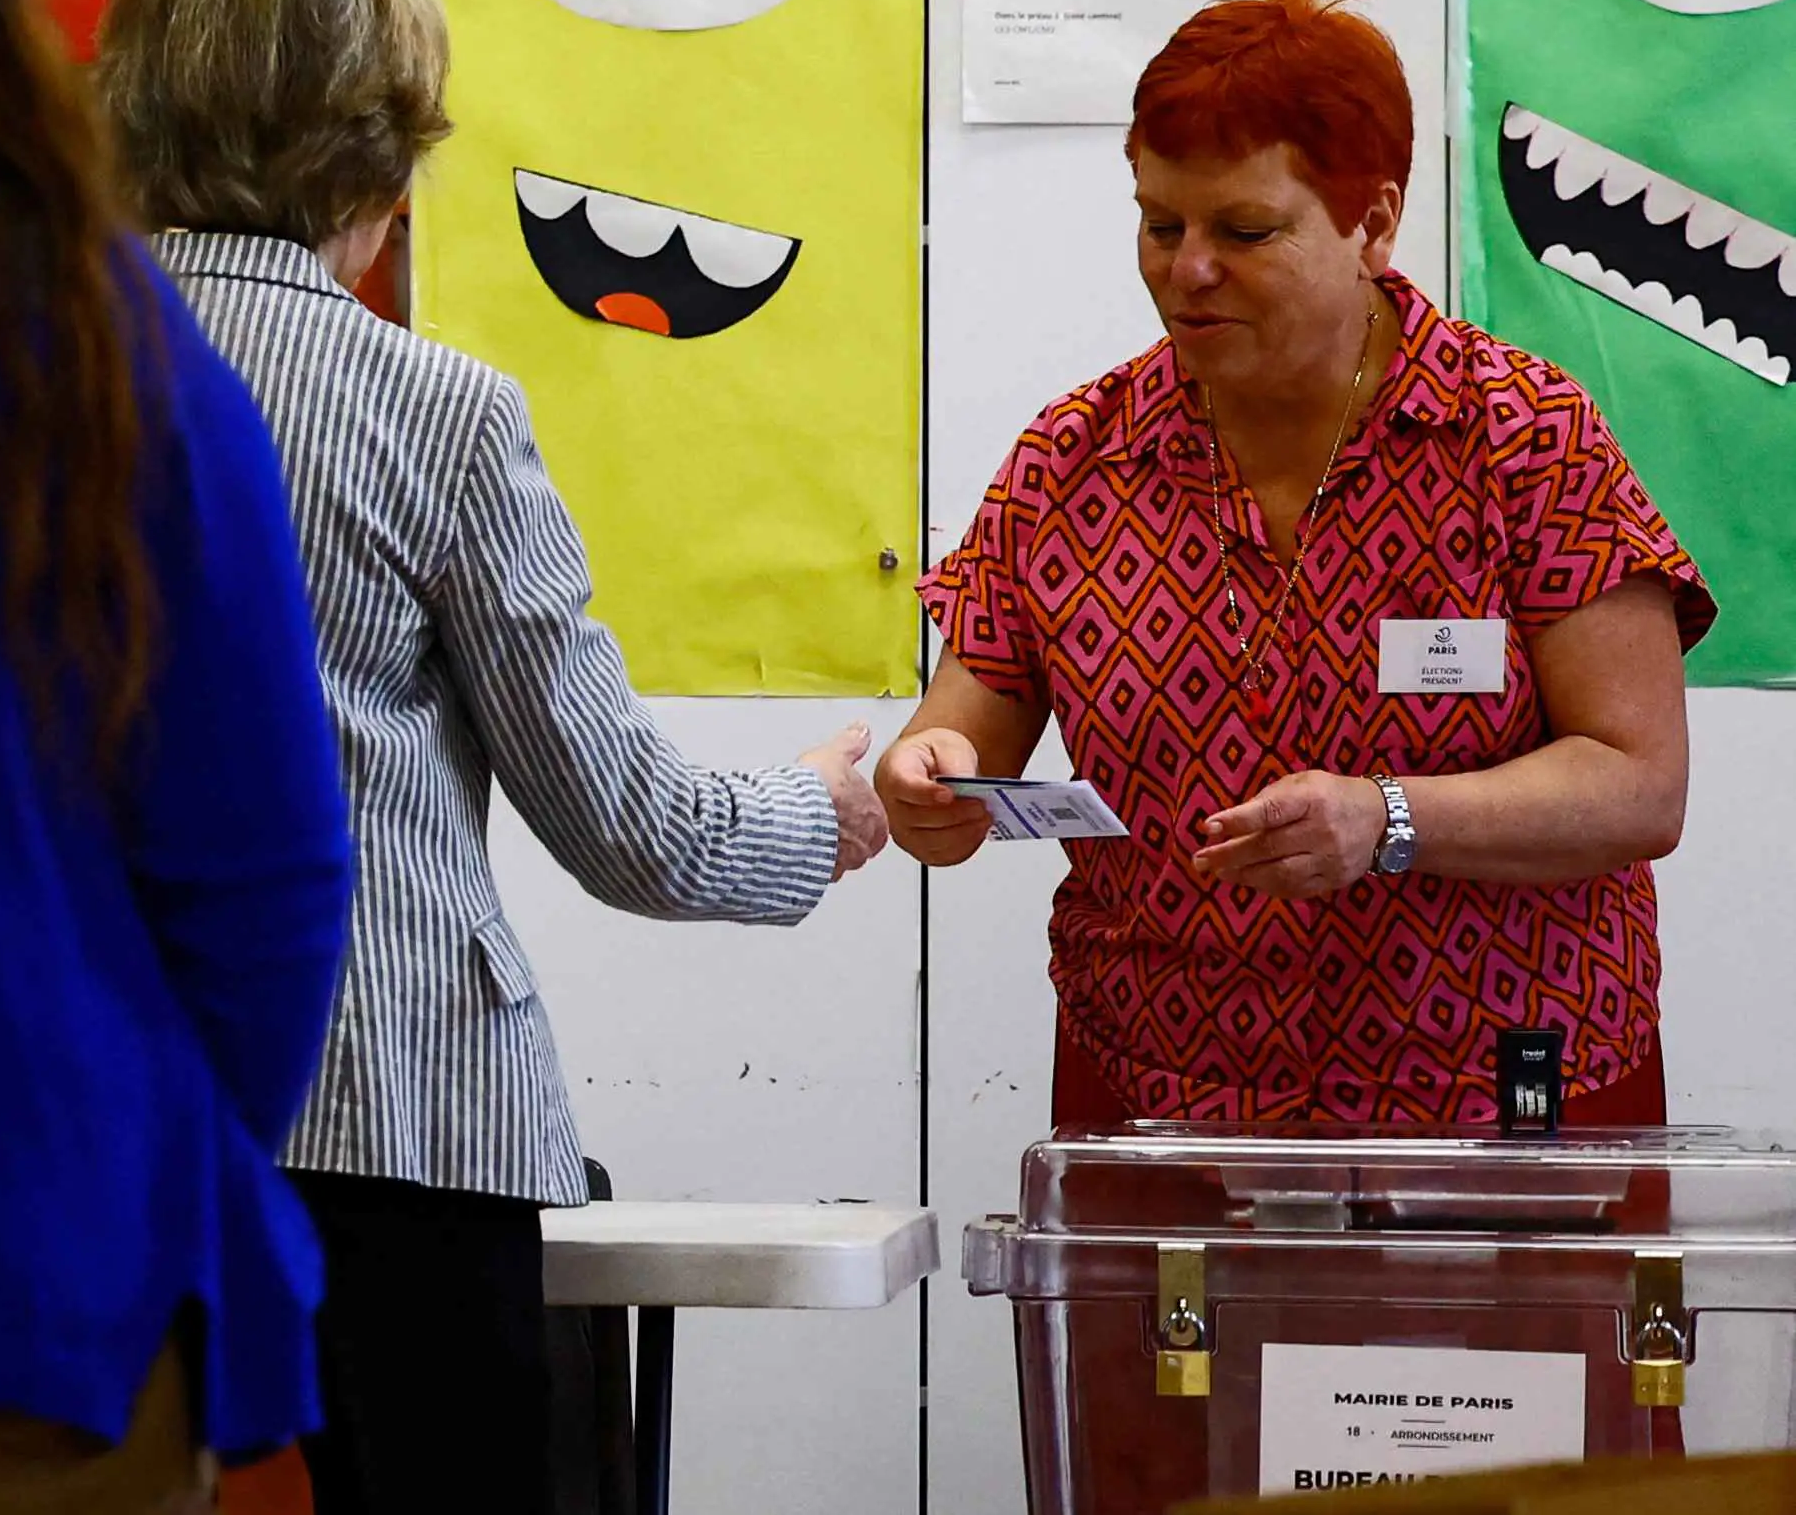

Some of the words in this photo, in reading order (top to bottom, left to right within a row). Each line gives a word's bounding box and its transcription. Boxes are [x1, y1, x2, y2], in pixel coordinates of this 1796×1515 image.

[1333, 1392, 1408, 1407] MAIRIE
[1415, 1395, 1444, 1408] DE
[1451, 1397, 1514, 1411] PARIS
[1346, 1426, 1361, 1437] 18
[1390, 1429, 1496, 1443] ARRONDISSEMENT
